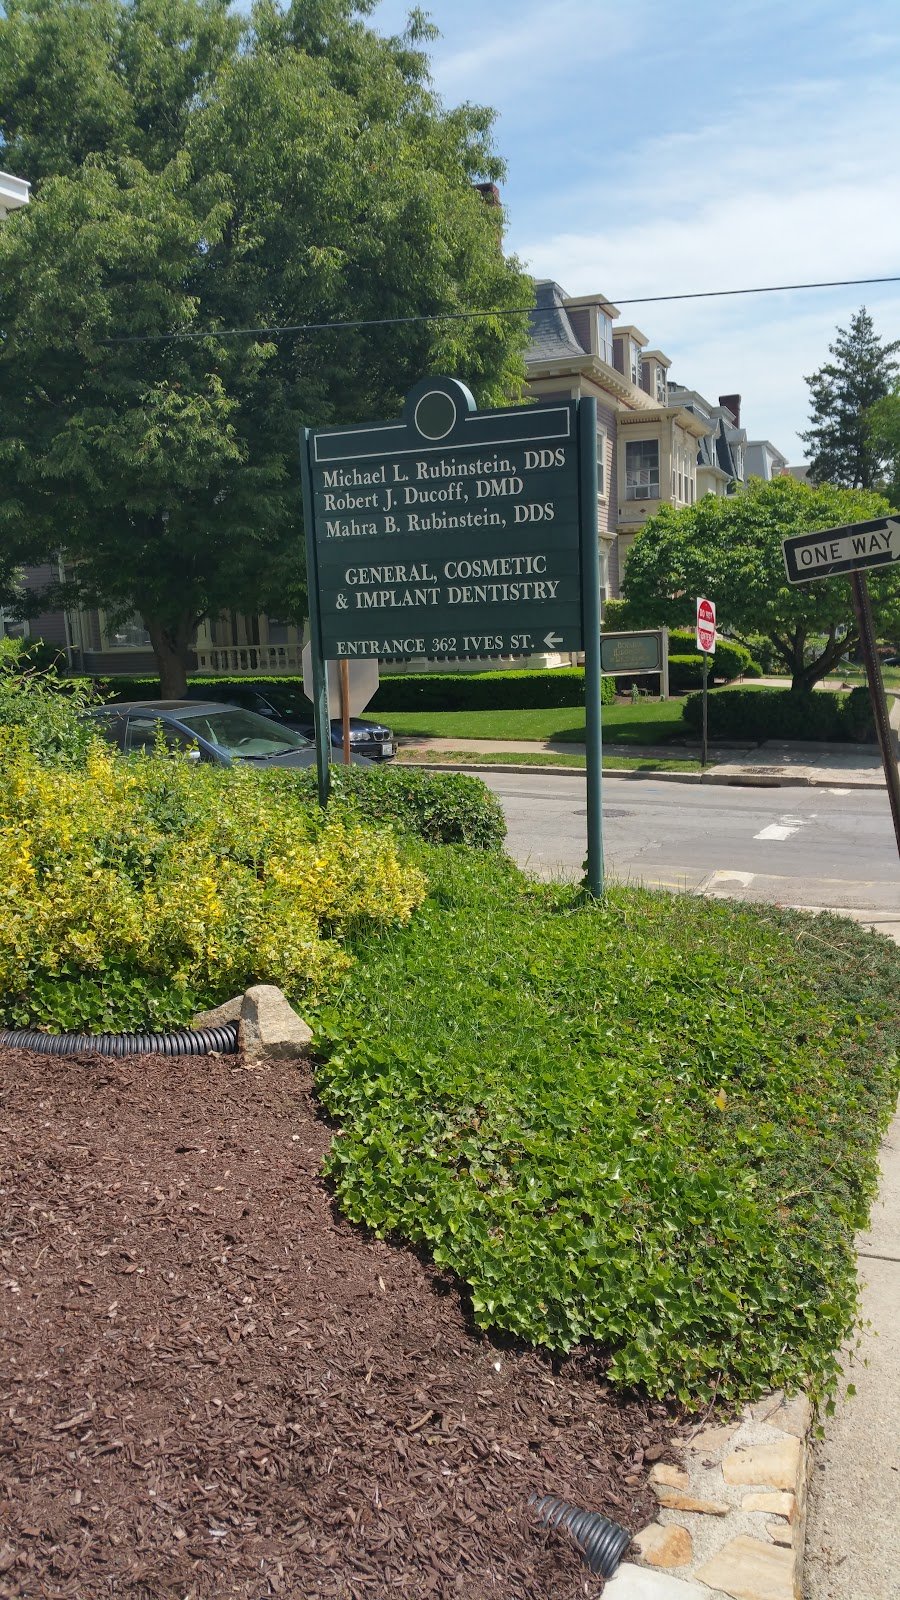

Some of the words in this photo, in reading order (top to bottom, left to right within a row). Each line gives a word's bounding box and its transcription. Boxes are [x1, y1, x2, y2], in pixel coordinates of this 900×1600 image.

[323, 465, 386, 488] Michael
[393, 464, 409, 482] L.
[416, 454, 516, 479] Rubinstein,
[524, 448, 566, 470] DDS
[324, 491, 378, 511] Robert
[383, 489, 397, 512] J.
[404, 483, 468, 505] Ducoff,
[476, 477, 523, 498] DMD
[326, 520, 377, 538] Mahra
[385, 517, 400, 533] B.
[407, 507, 506, 532] Rubinstein,
[514, 503, 555, 523] DDS
[801, 543, 842, 565] ONE
[852, 531, 893, 555] WAY
[345, 564, 437, 585] GENERAL,
[444, 555, 547, 579] COSMETIC
[336, 593, 349, 609] &
[355, 588, 440, 609] IMPLANT
[448, 581, 561, 604] DENTISTRY
[337, 639, 425, 655] ENTRANCE
[432, 638, 457, 652] 362
[463, 635, 504, 650] IVES
[510, 634, 535, 648] ST.
